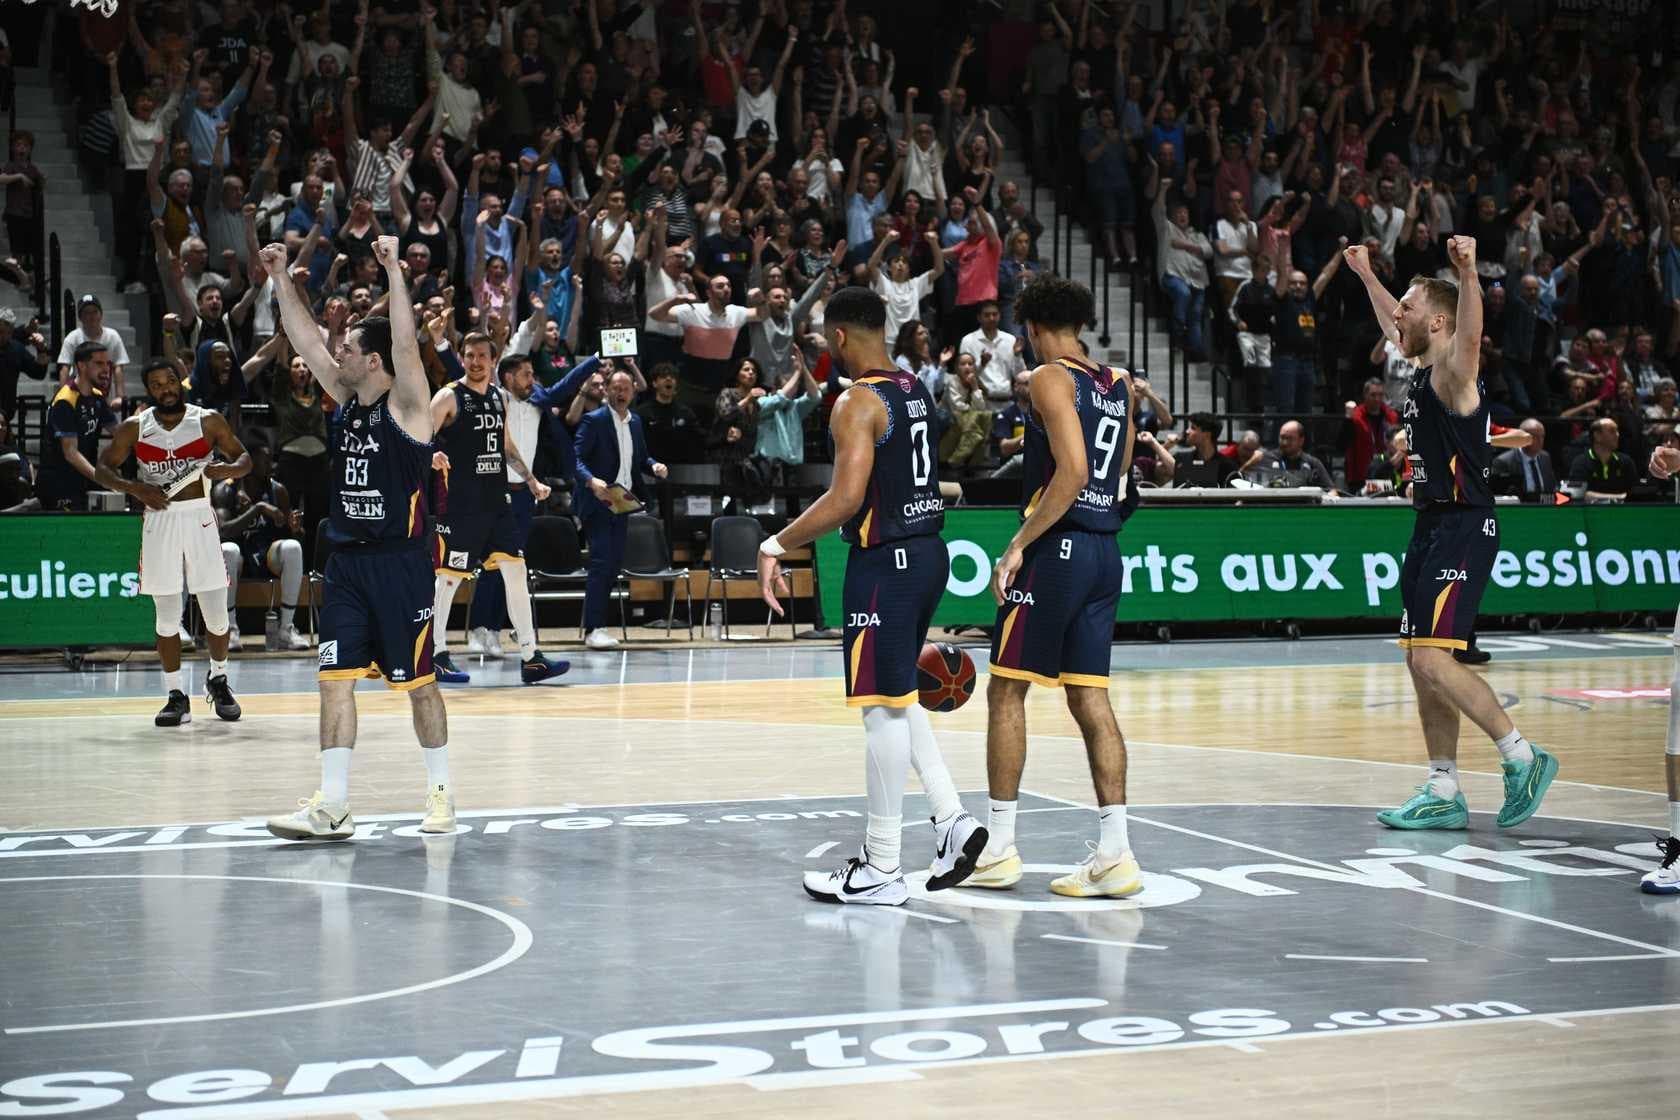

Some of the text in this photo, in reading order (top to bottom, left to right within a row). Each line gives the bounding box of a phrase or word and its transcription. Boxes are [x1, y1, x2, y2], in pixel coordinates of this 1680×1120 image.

[219, 37, 248, 49] JDA
[474, 414, 505, 431] JDA
[340, 429, 380, 455] JDA
[487, 432, 498, 452] 15
[1094, 416, 1121, 480] 9
[910, 420, 931, 487] 0
[345, 456, 369, 487] 83
[1482, 518, 1496, 537] 43
[894, 547, 908, 570] 0
[1059, 537, 1073, 560] 9
[946, 531, 1680, 606] Orts aux pession
[1435, 569, 1468, 581] JDA
[1005, 588, 1036, 607] JDA
[847, 612, 881, 627] JDA
